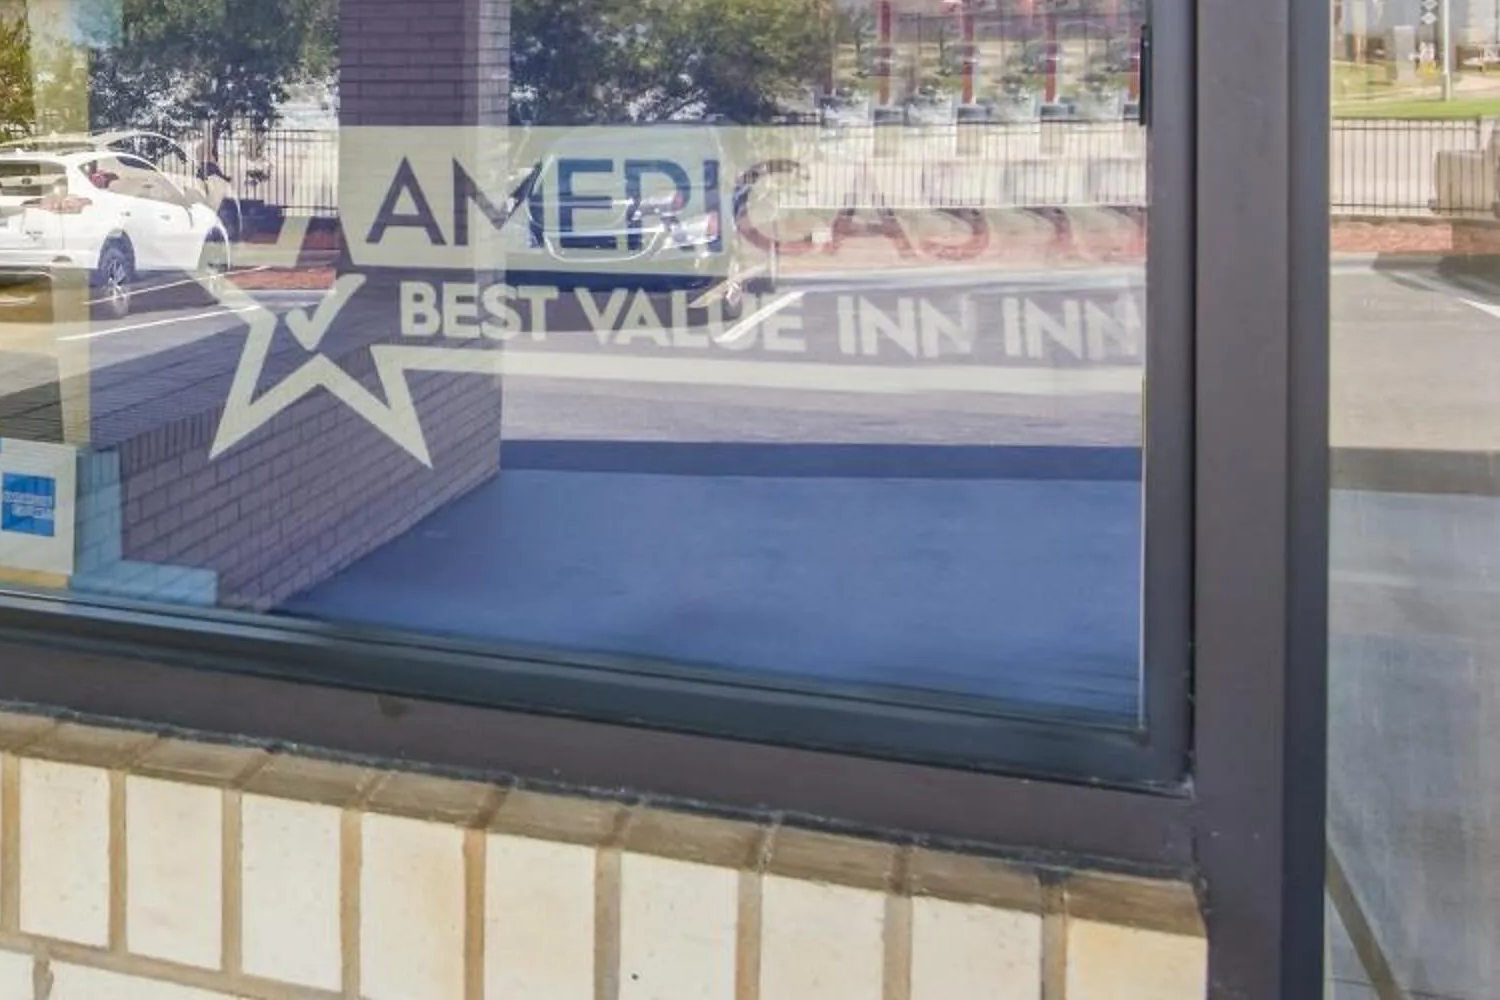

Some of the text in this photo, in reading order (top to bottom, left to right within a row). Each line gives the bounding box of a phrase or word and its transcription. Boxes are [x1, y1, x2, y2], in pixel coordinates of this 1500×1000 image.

[401, 279, 1141, 361] BEST VALUE INN INN
